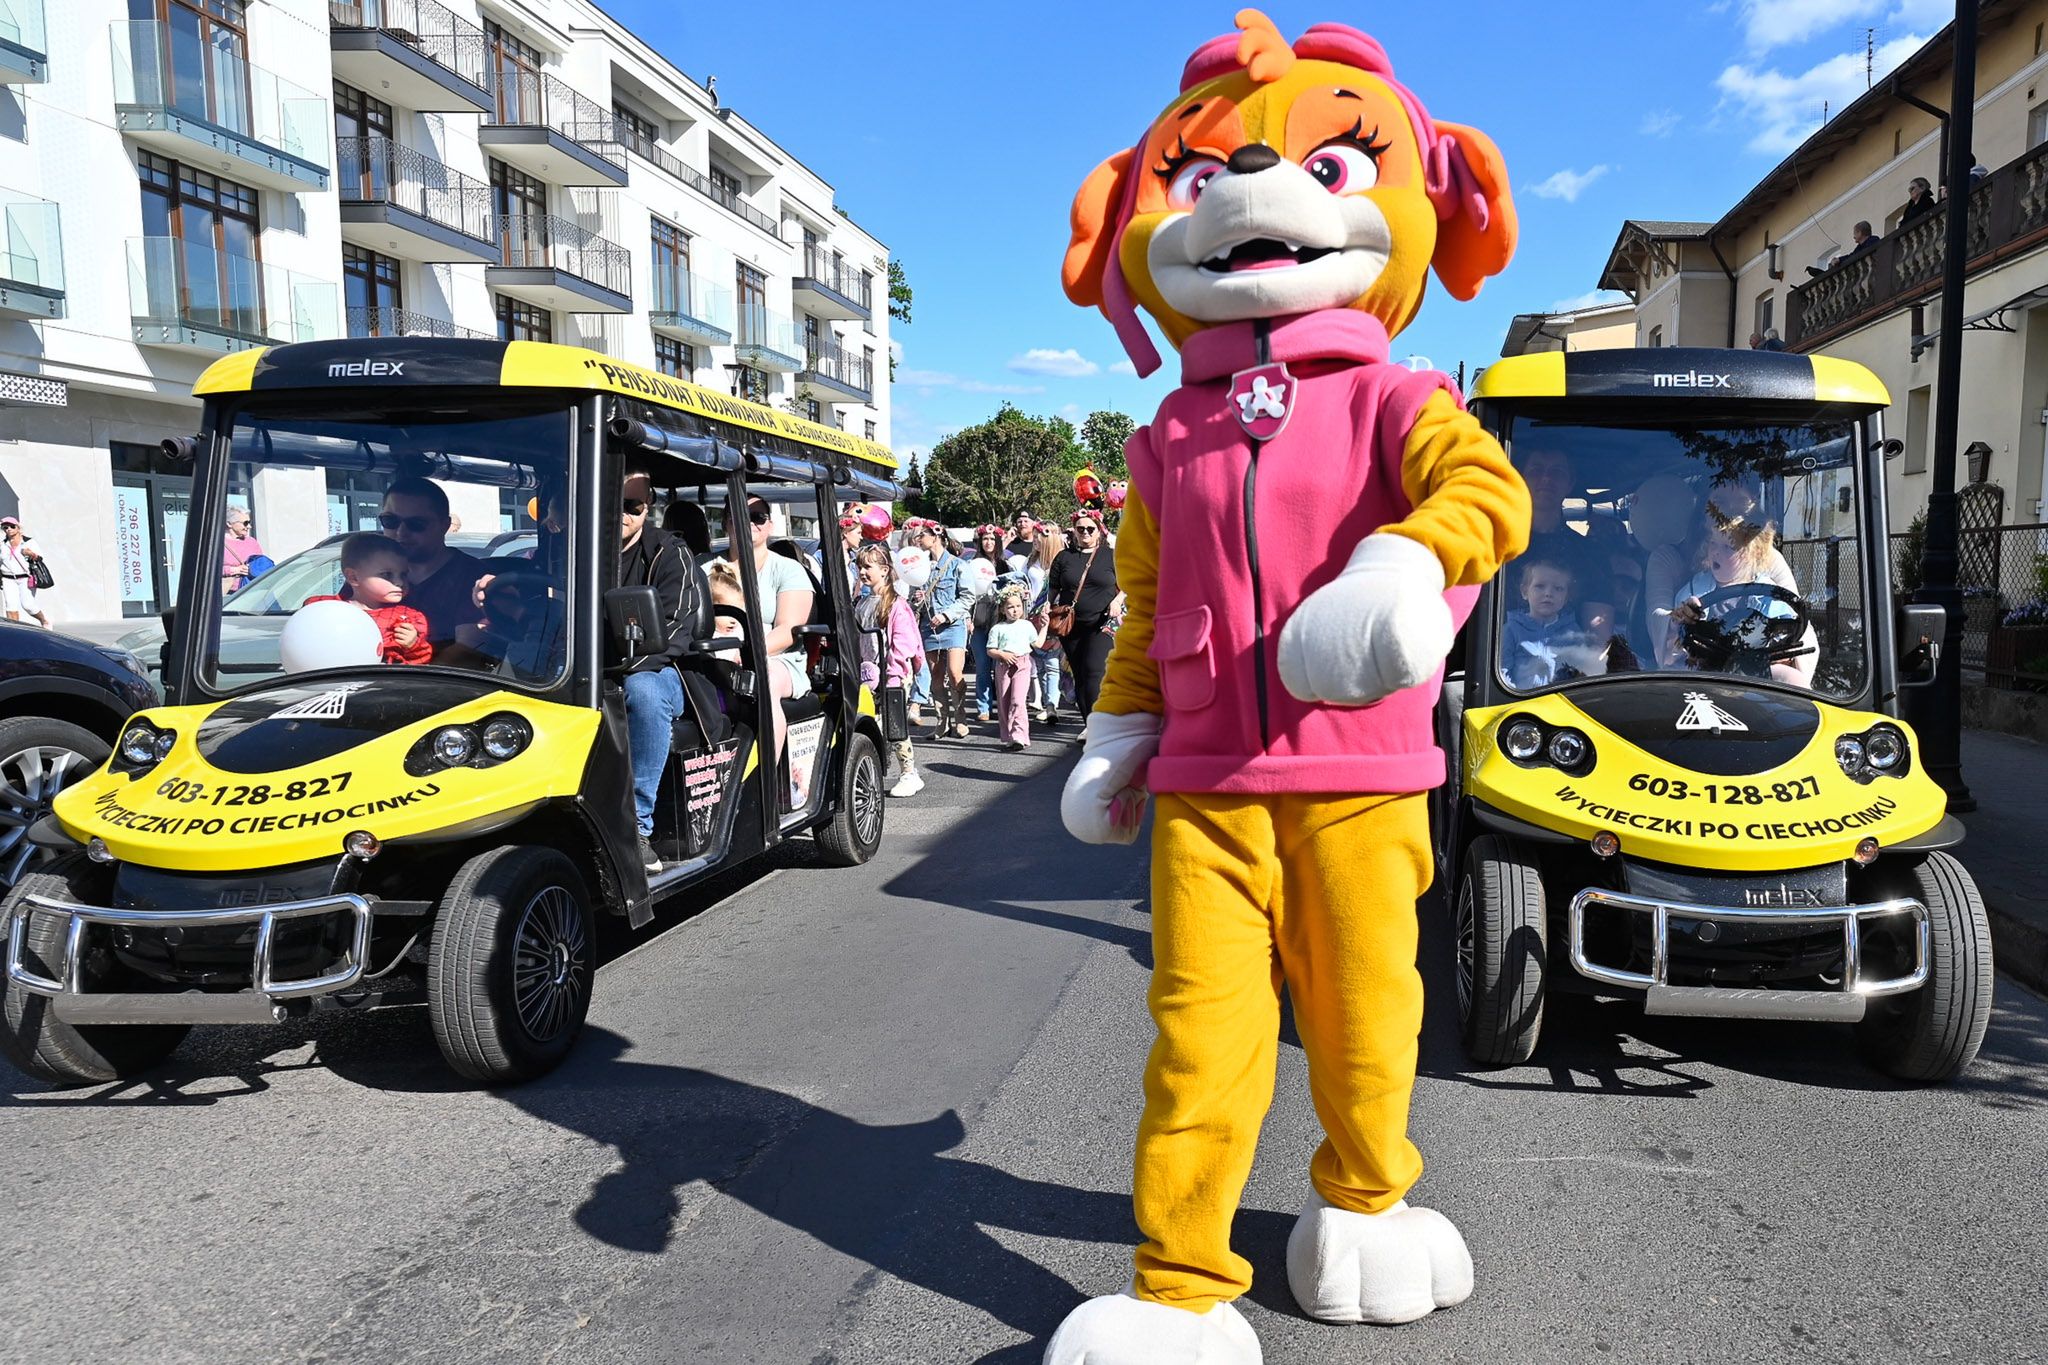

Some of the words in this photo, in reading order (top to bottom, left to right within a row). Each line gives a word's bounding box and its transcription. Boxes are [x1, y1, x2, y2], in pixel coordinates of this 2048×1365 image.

[328, 358, 404, 377] melex
[1653, 369, 1731, 388] melex
[118, 493, 126, 525] LOKAL
[128, 507, 139, 530] 796
[130, 534, 140, 557] 227
[132, 560, 142, 584] 806
[156, 771, 353, 806] 603-128-827
[1628, 773, 1821, 805] 603-128-827
[94, 788, 184, 834] WYCIECZKI
[181, 818, 225, 835] PO
[229, 782, 441, 834] CIECHOCINKU
[1554, 785, 1692, 836] WYCIECZKI
[1699, 822, 1739, 839] PO
[1745, 795, 1897, 840] CIECHOCINKU
